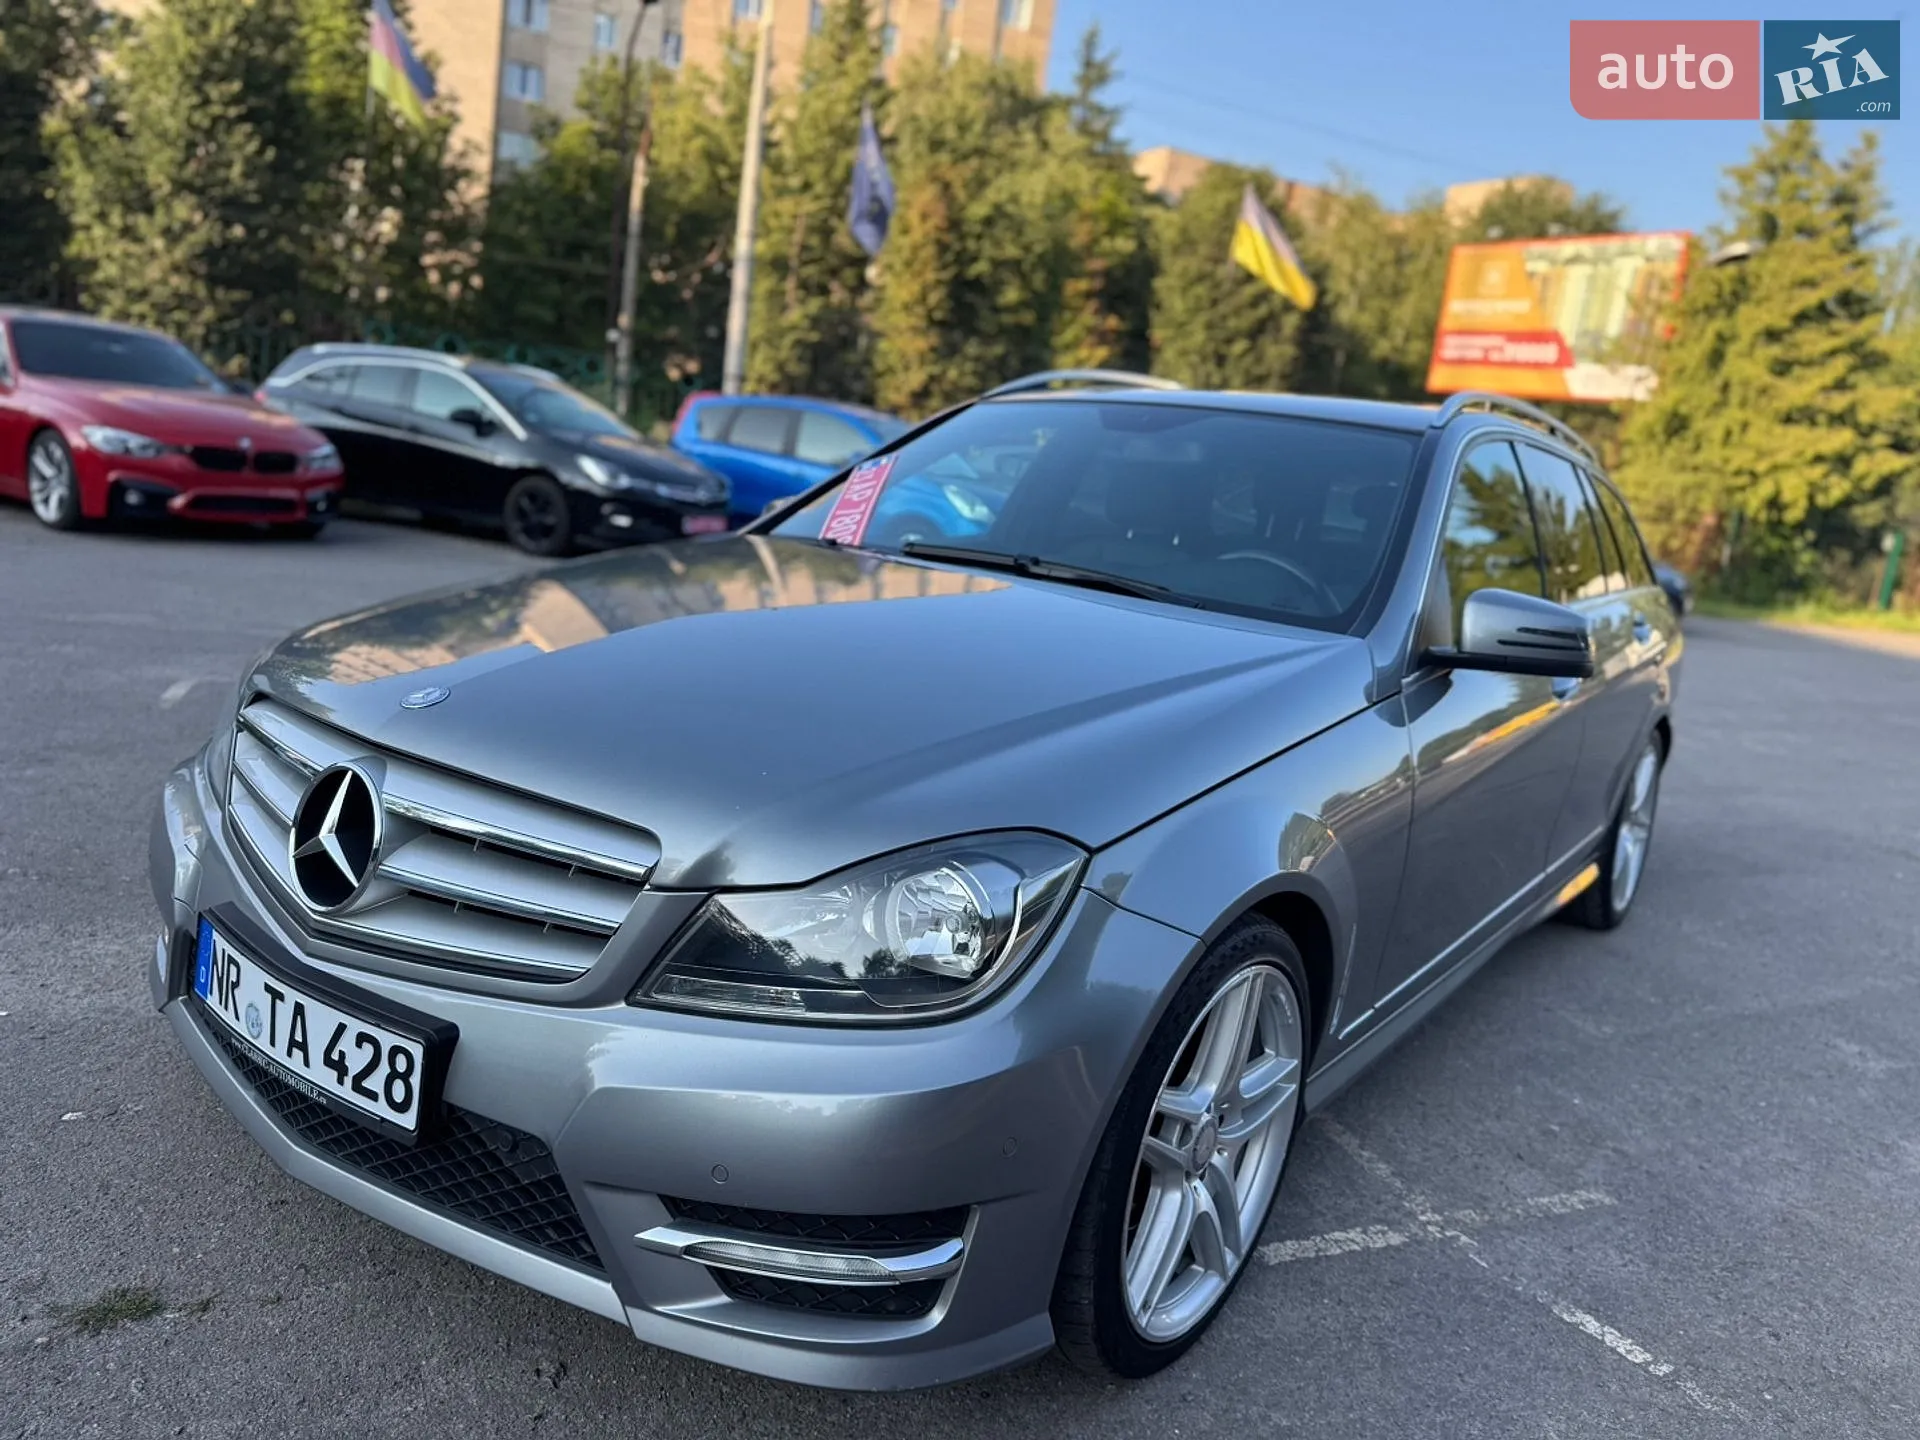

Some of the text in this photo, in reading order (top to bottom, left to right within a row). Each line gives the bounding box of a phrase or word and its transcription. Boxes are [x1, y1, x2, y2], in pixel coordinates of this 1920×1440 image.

[210, 938, 241, 1022] NR
[263, 981, 311, 1069] TA
[322, 1021, 415, 1114] 428
